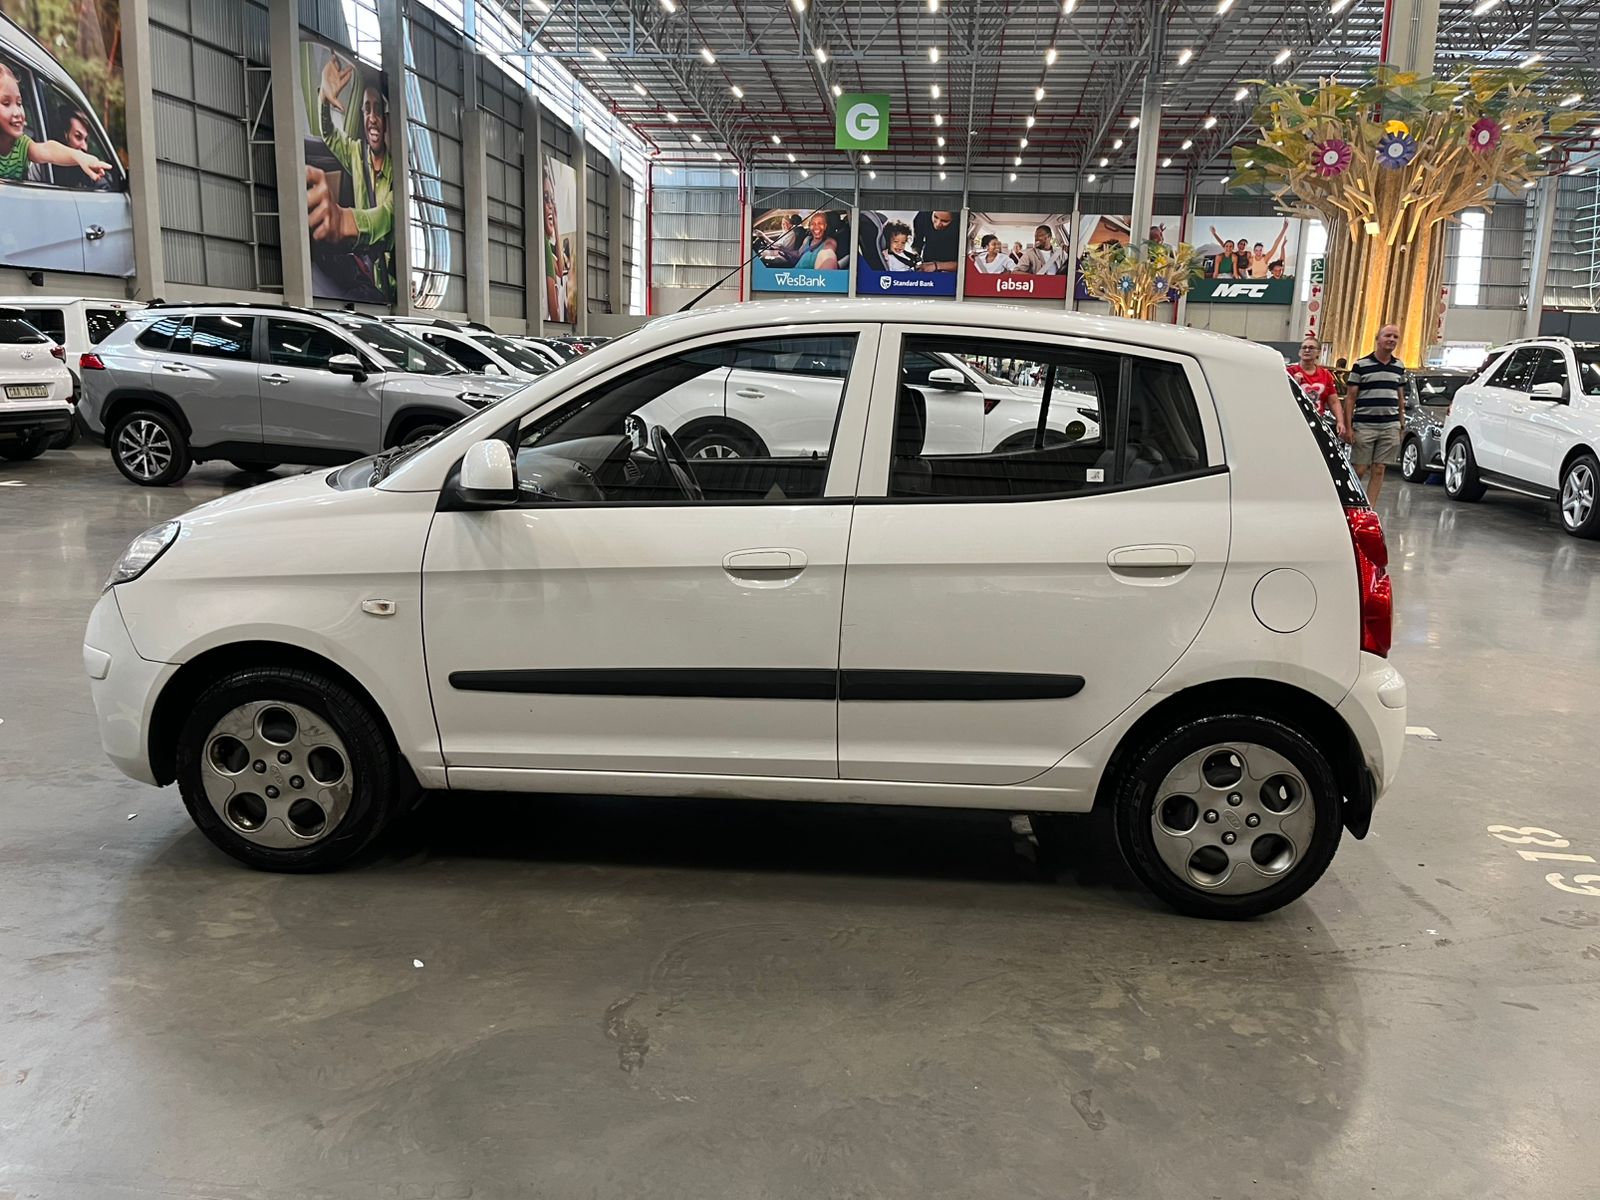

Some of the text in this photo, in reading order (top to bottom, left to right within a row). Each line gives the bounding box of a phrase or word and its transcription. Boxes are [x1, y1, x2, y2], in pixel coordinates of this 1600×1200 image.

[845, 102, 880, 141] G
[774, 272, 826, 287] WesBank
[892, 279, 919, 287] Standard
[1211, 283, 1269, 298] MFC
